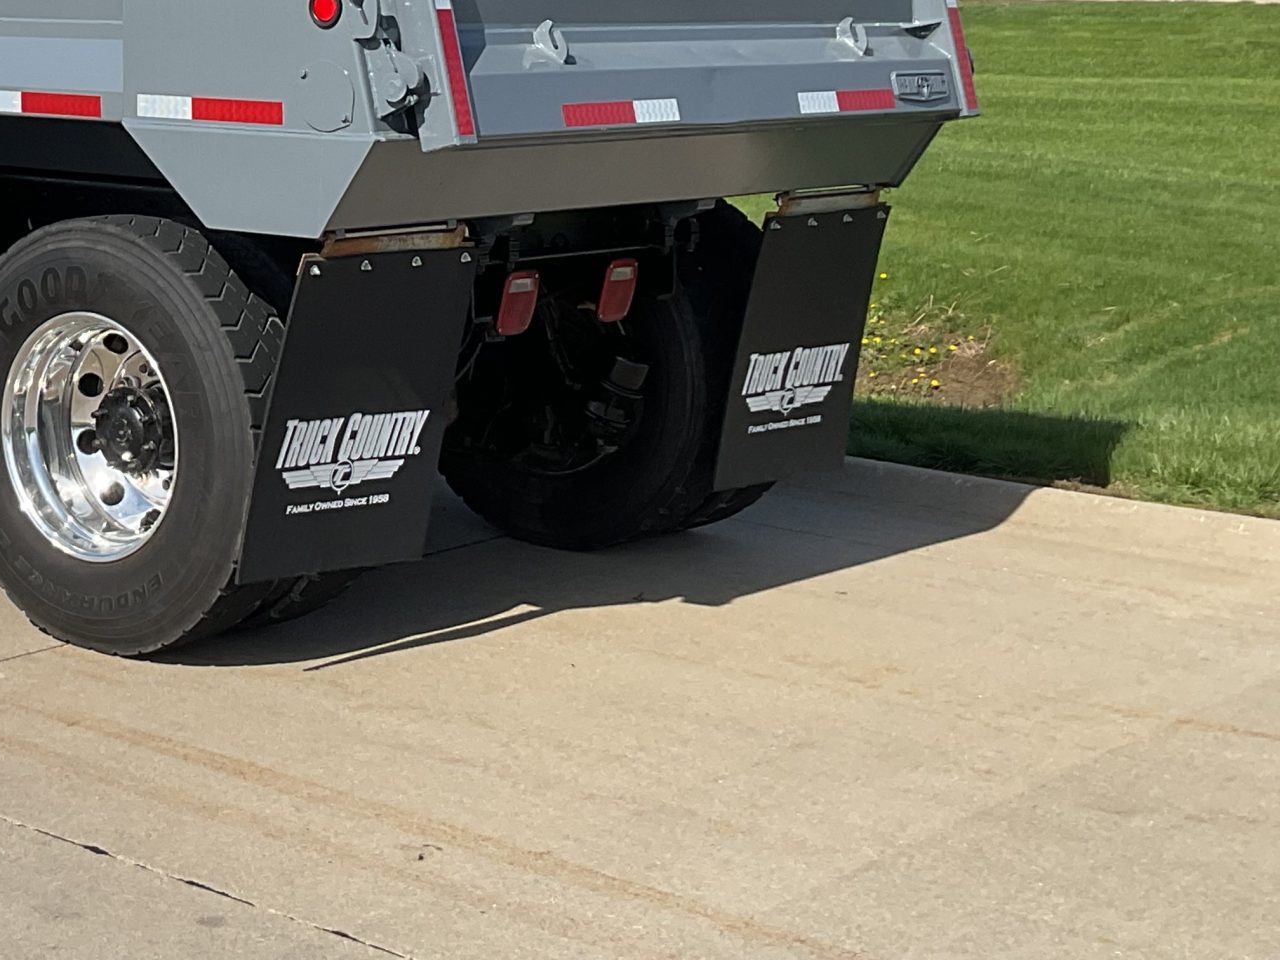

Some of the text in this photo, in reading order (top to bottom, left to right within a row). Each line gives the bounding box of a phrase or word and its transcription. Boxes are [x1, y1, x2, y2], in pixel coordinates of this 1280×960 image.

[741, 351, 791, 396] TRUCK
[275, 417, 345, 469] TRUCK
[286, 493, 390, 515] FAMILY OWNED SINCE 1958
